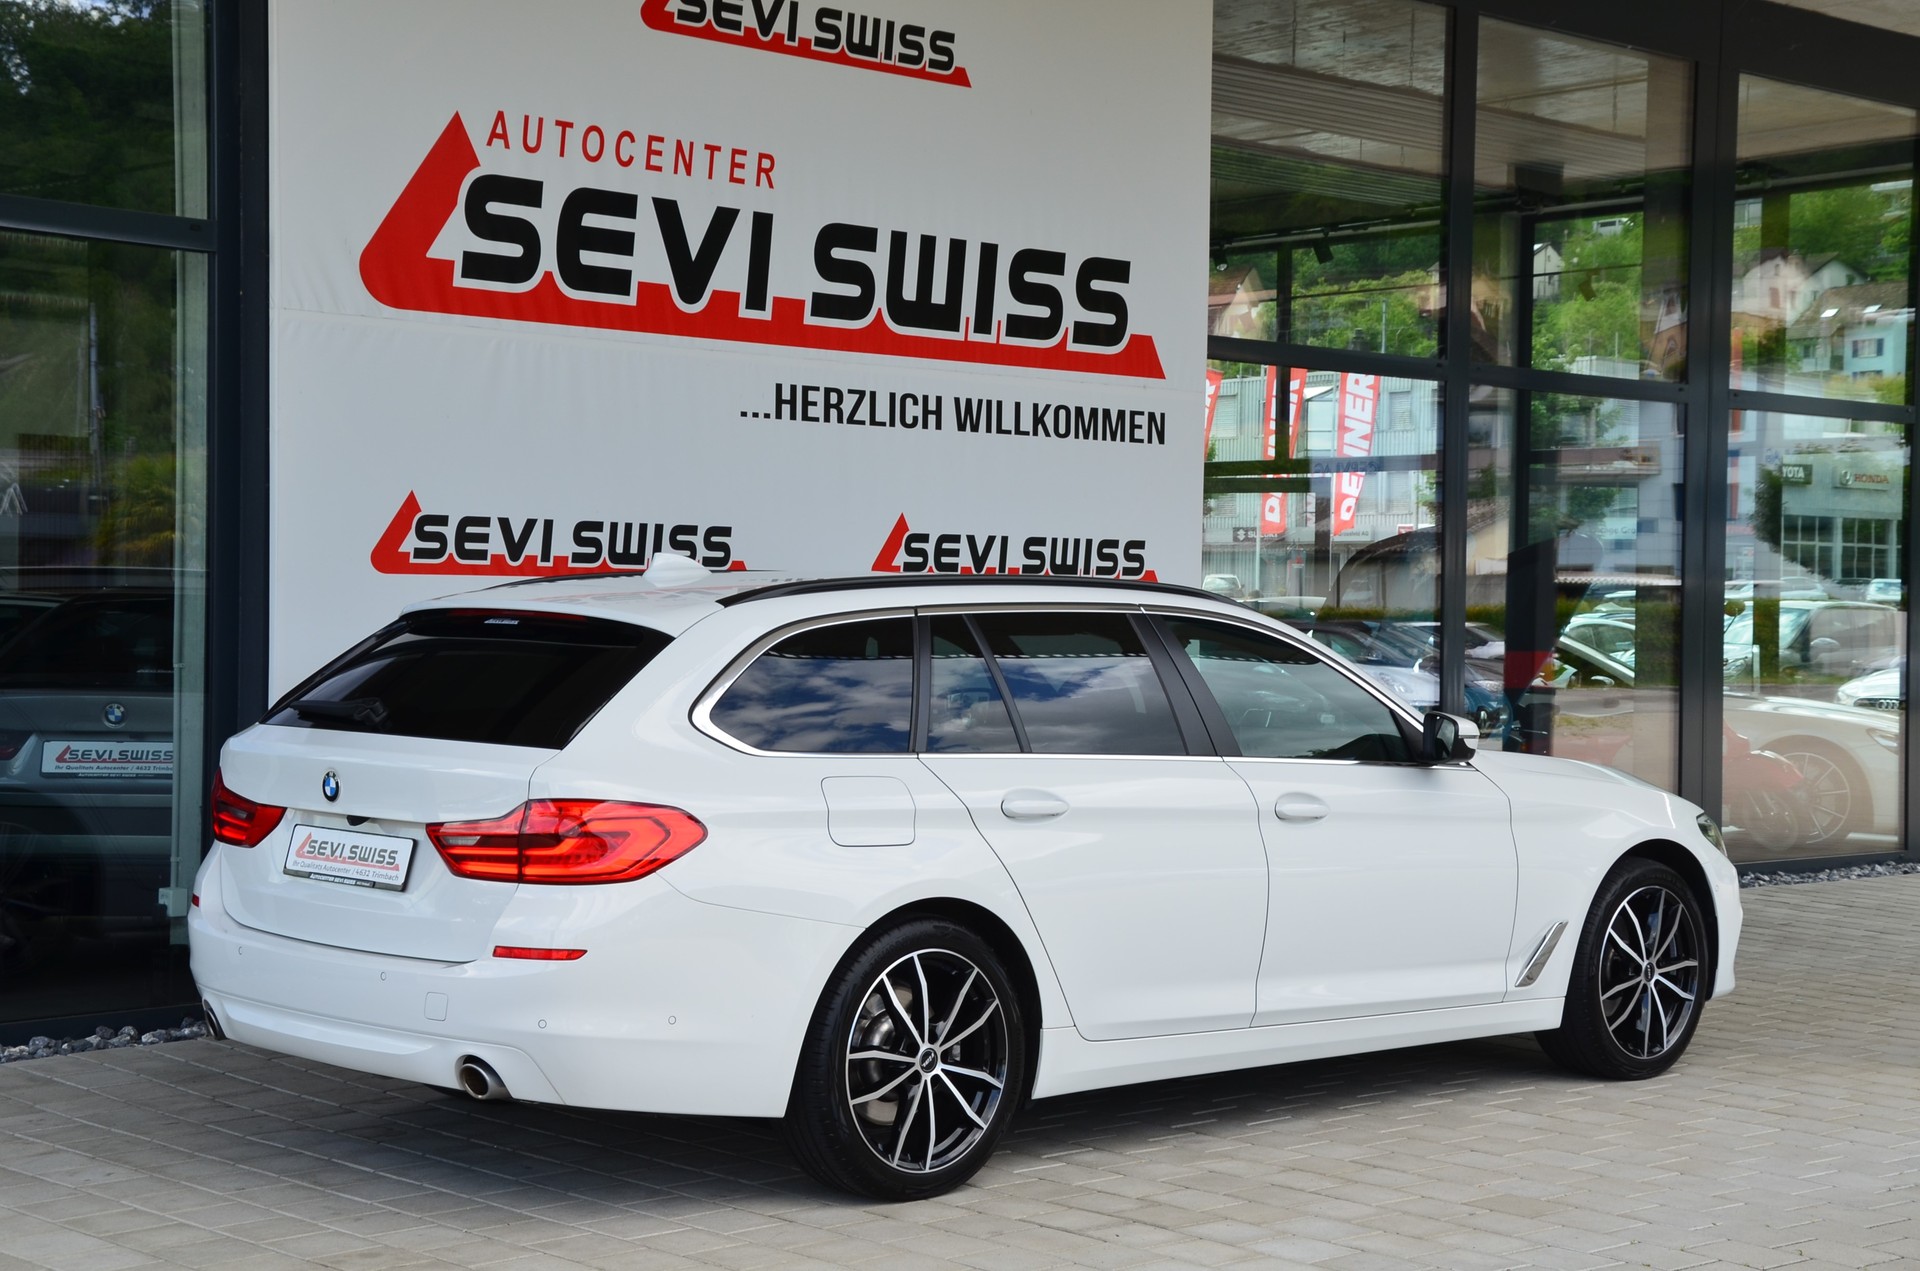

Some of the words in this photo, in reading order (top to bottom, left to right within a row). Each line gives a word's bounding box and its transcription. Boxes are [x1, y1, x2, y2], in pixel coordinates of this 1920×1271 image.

[676, 0, 799, 43] SEVI
[813, 7, 956, 72] SWISS
[486, 109, 777, 190] AUTOCENTER
[461, 174, 775, 312] SEVI
[810, 222, 1132, 348] SWISS
[739, 382, 943, 431] ...HERZLICH
[953, 396, 1166, 446] WILLKOMMEN
[1782, 465, 1805, 478] YOTA
[1854, 473, 1889, 484] HONDA
[412, 514, 555, 564] SEVI
[571, 520, 733, 568] SWISS
[902, 532, 1009, 575] SEVI
[1021, 536, 1146, 577] SWISS
[67, 749, 114, 761] SEVI
[117, 749, 174, 762] SWISS
[306, 839, 346, 859] SEVI
[347, 844, 399, 866] SWISS
[323, 864, 352, 874] Autocenter
[355, 868, 371, 877] 4632
[371, 870, 400, 881] Trimbach
